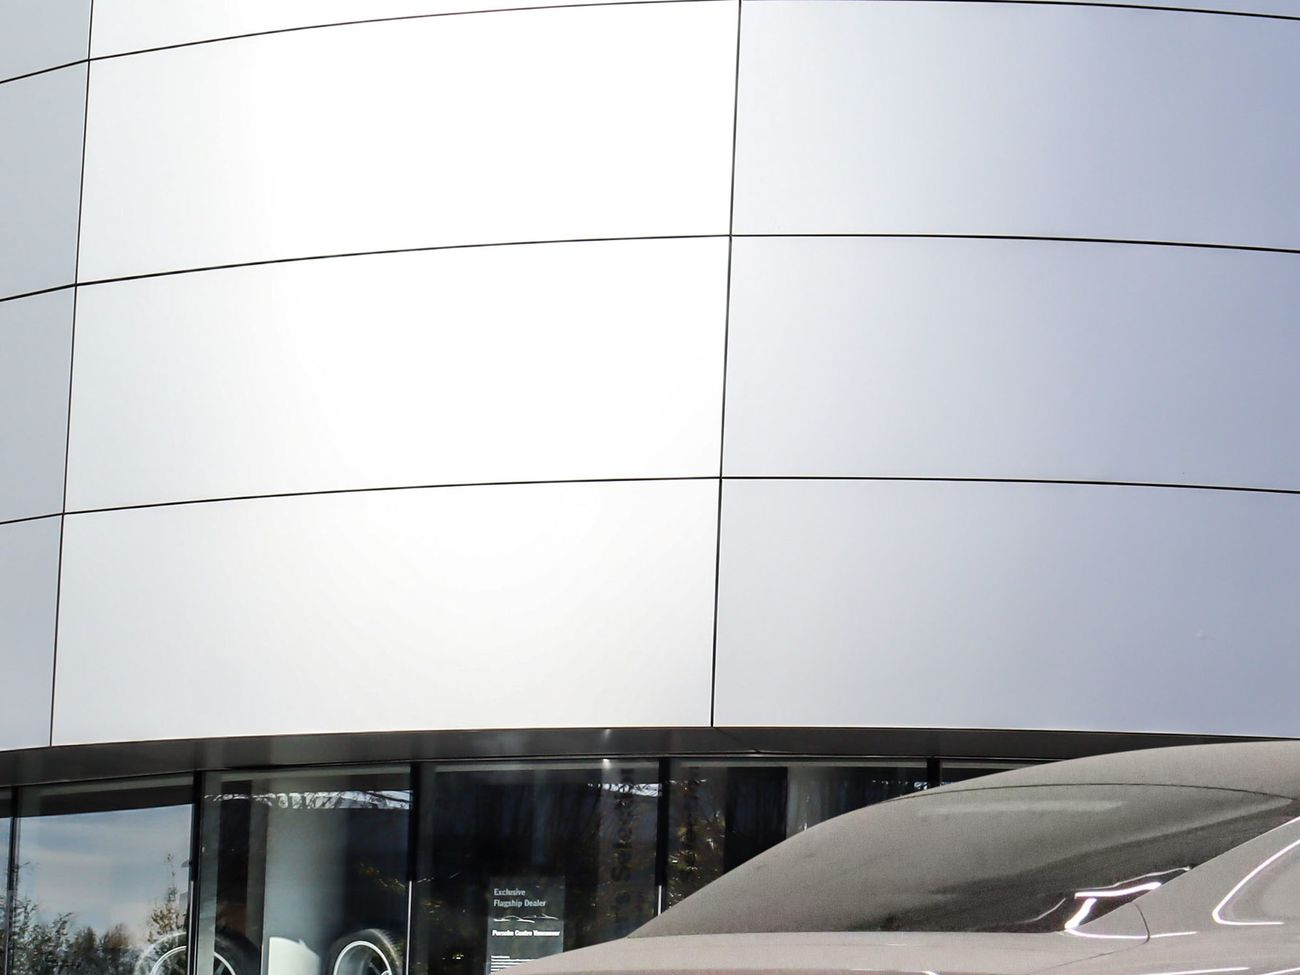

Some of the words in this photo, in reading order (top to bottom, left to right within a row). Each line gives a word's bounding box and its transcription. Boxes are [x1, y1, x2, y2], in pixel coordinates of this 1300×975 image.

[493, 888, 526, 896] Exclusive
[493, 899, 522, 908] Flagship
[524, 899, 546, 907] Dealer
